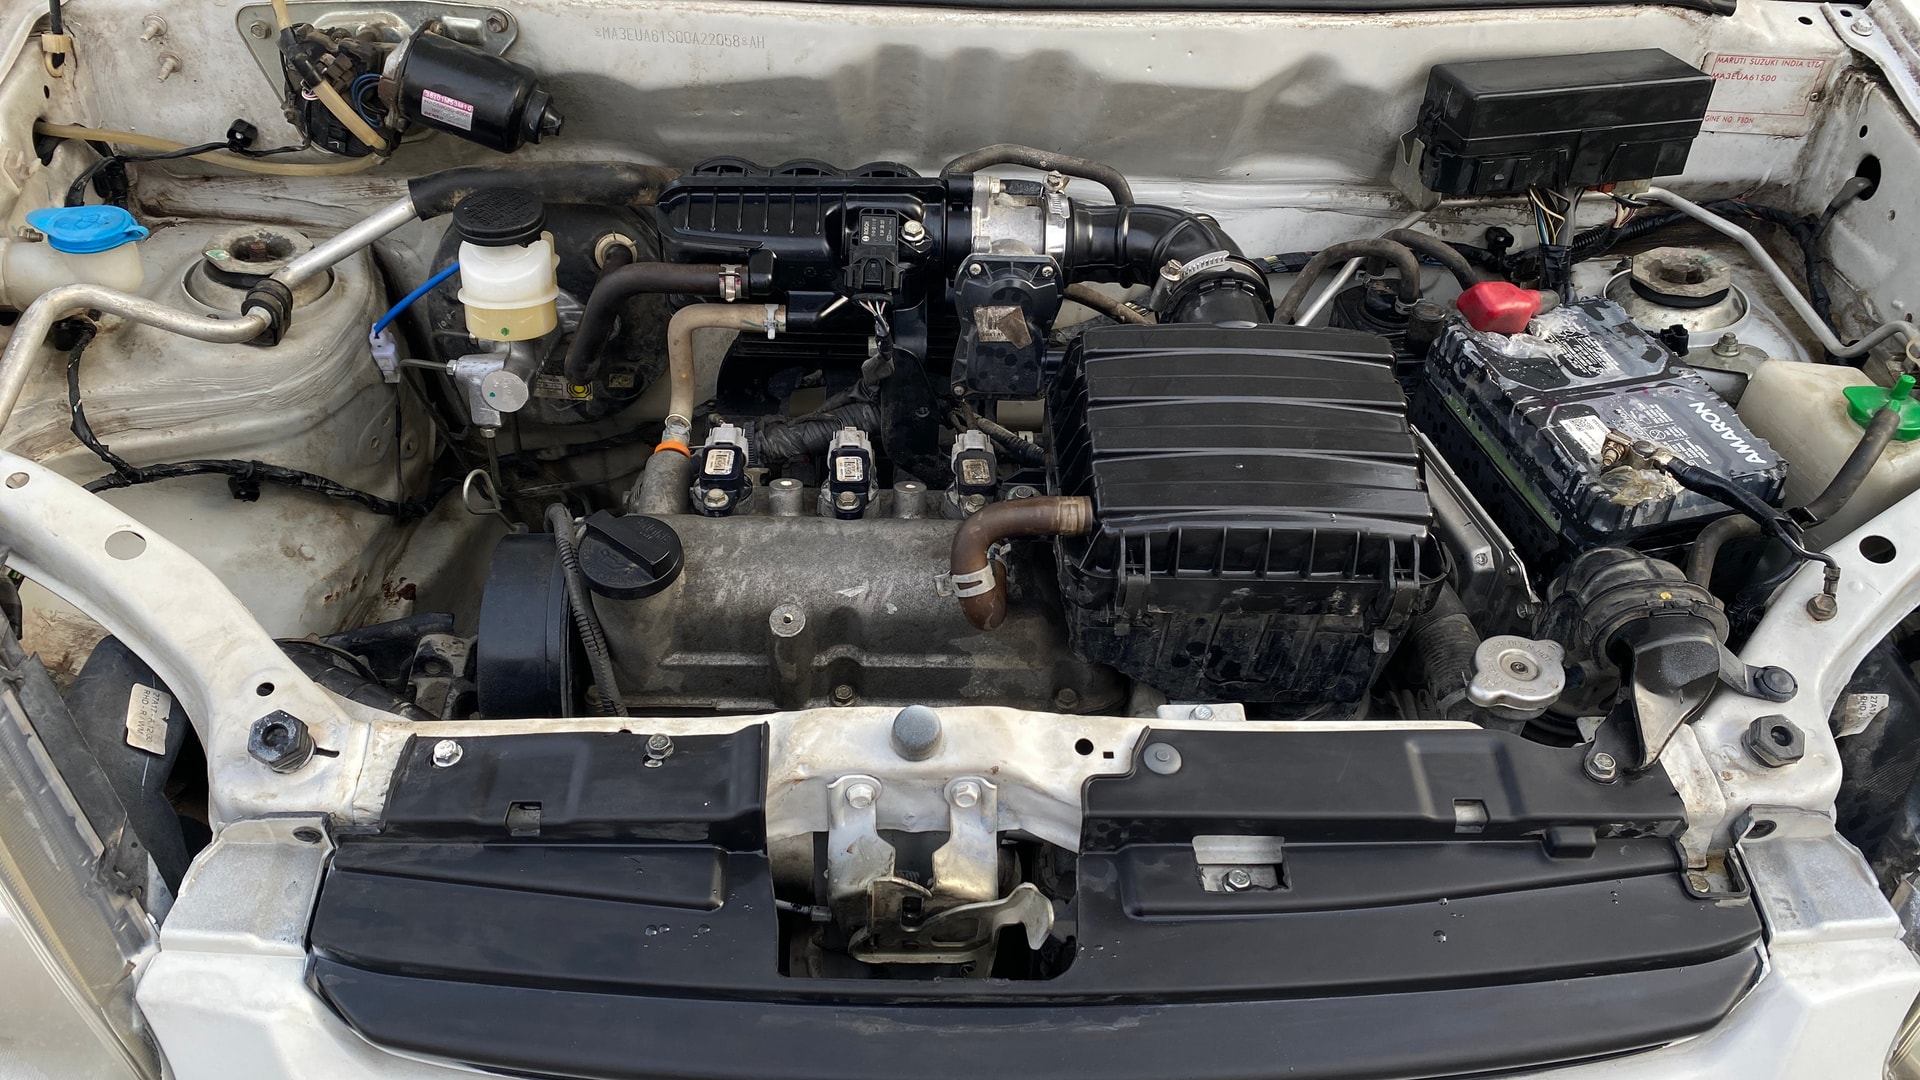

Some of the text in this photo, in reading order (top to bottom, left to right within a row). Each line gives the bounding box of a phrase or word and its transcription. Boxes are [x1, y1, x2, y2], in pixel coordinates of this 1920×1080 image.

[1716, 57, 1746, 65] MARUTI
[1749, 58, 1778, 67] SUZUKI
[1781, 60, 1804, 68] INDIA
[1704, 115, 1720, 123] GINE
[1688, 401, 1768, 465] AMARON
[1535, 648, 1553, 664] HOT
